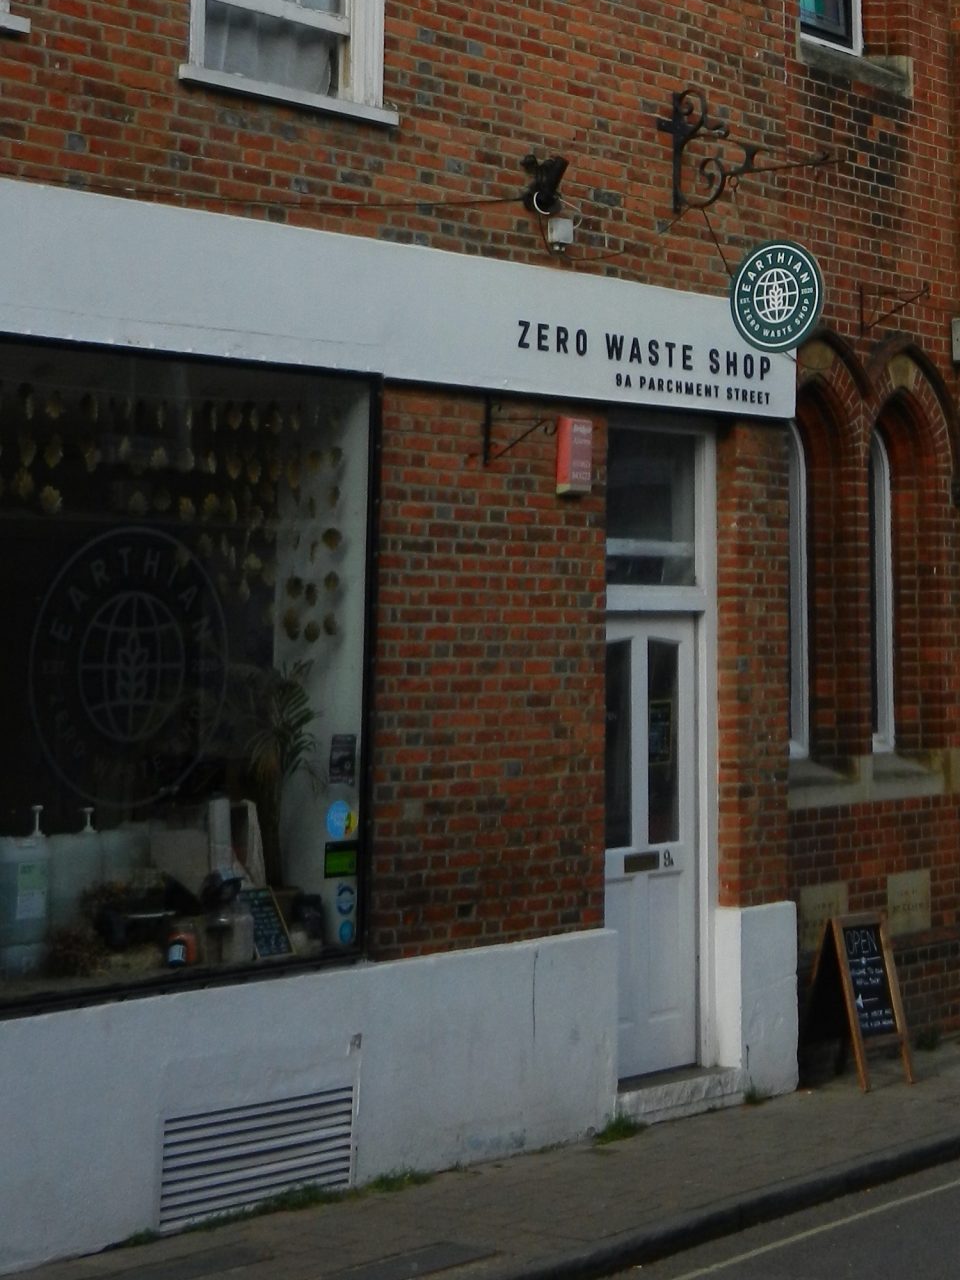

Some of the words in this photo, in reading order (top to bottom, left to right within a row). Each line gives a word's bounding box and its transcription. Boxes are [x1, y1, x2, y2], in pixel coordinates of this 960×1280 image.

[742, 252, 810, 292] EARTHIAN
[801, 287, 813, 295] 2020
[744, 308, 760, 331] ZERO
[763, 325, 792, 337] WASTE
[795, 298, 810, 325] SHOP
[518, 320, 588, 356] ZERO
[605, 333, 693, 371] WASTE
[708, 348, 771, 381] SHOP
[639, 376, 720, 398] PARCHMENT
[726, 387, 770, 405] STREET
[845, 930, 878, 955] OPEN
